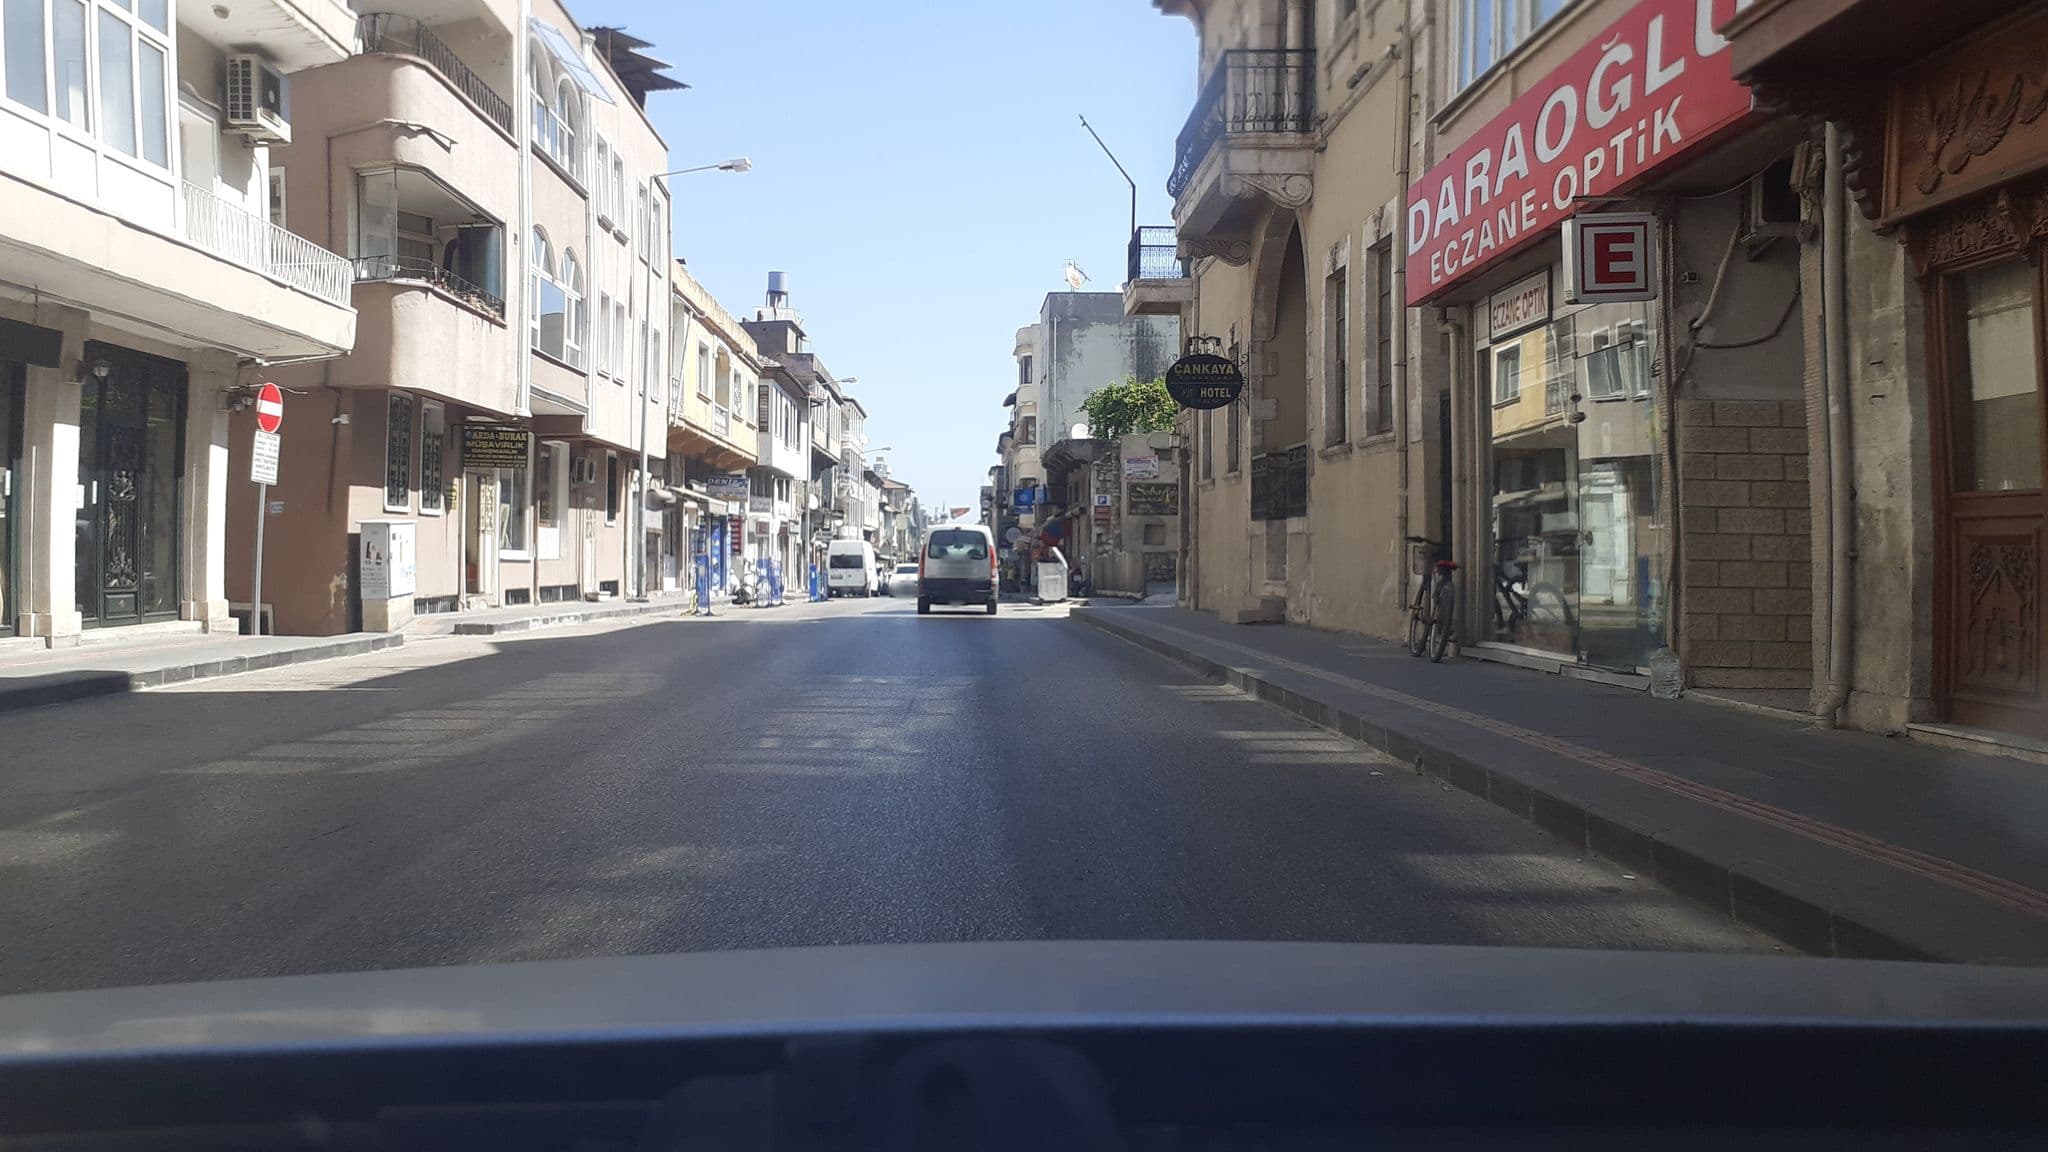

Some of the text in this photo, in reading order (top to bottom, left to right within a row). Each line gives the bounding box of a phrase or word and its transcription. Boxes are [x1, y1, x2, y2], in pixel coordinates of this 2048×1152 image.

[1594, 232, 1636, 283] E
[1493, 296, 1520, 330] ECZANE
[1200, 387, 1231, 398] HOTEL
